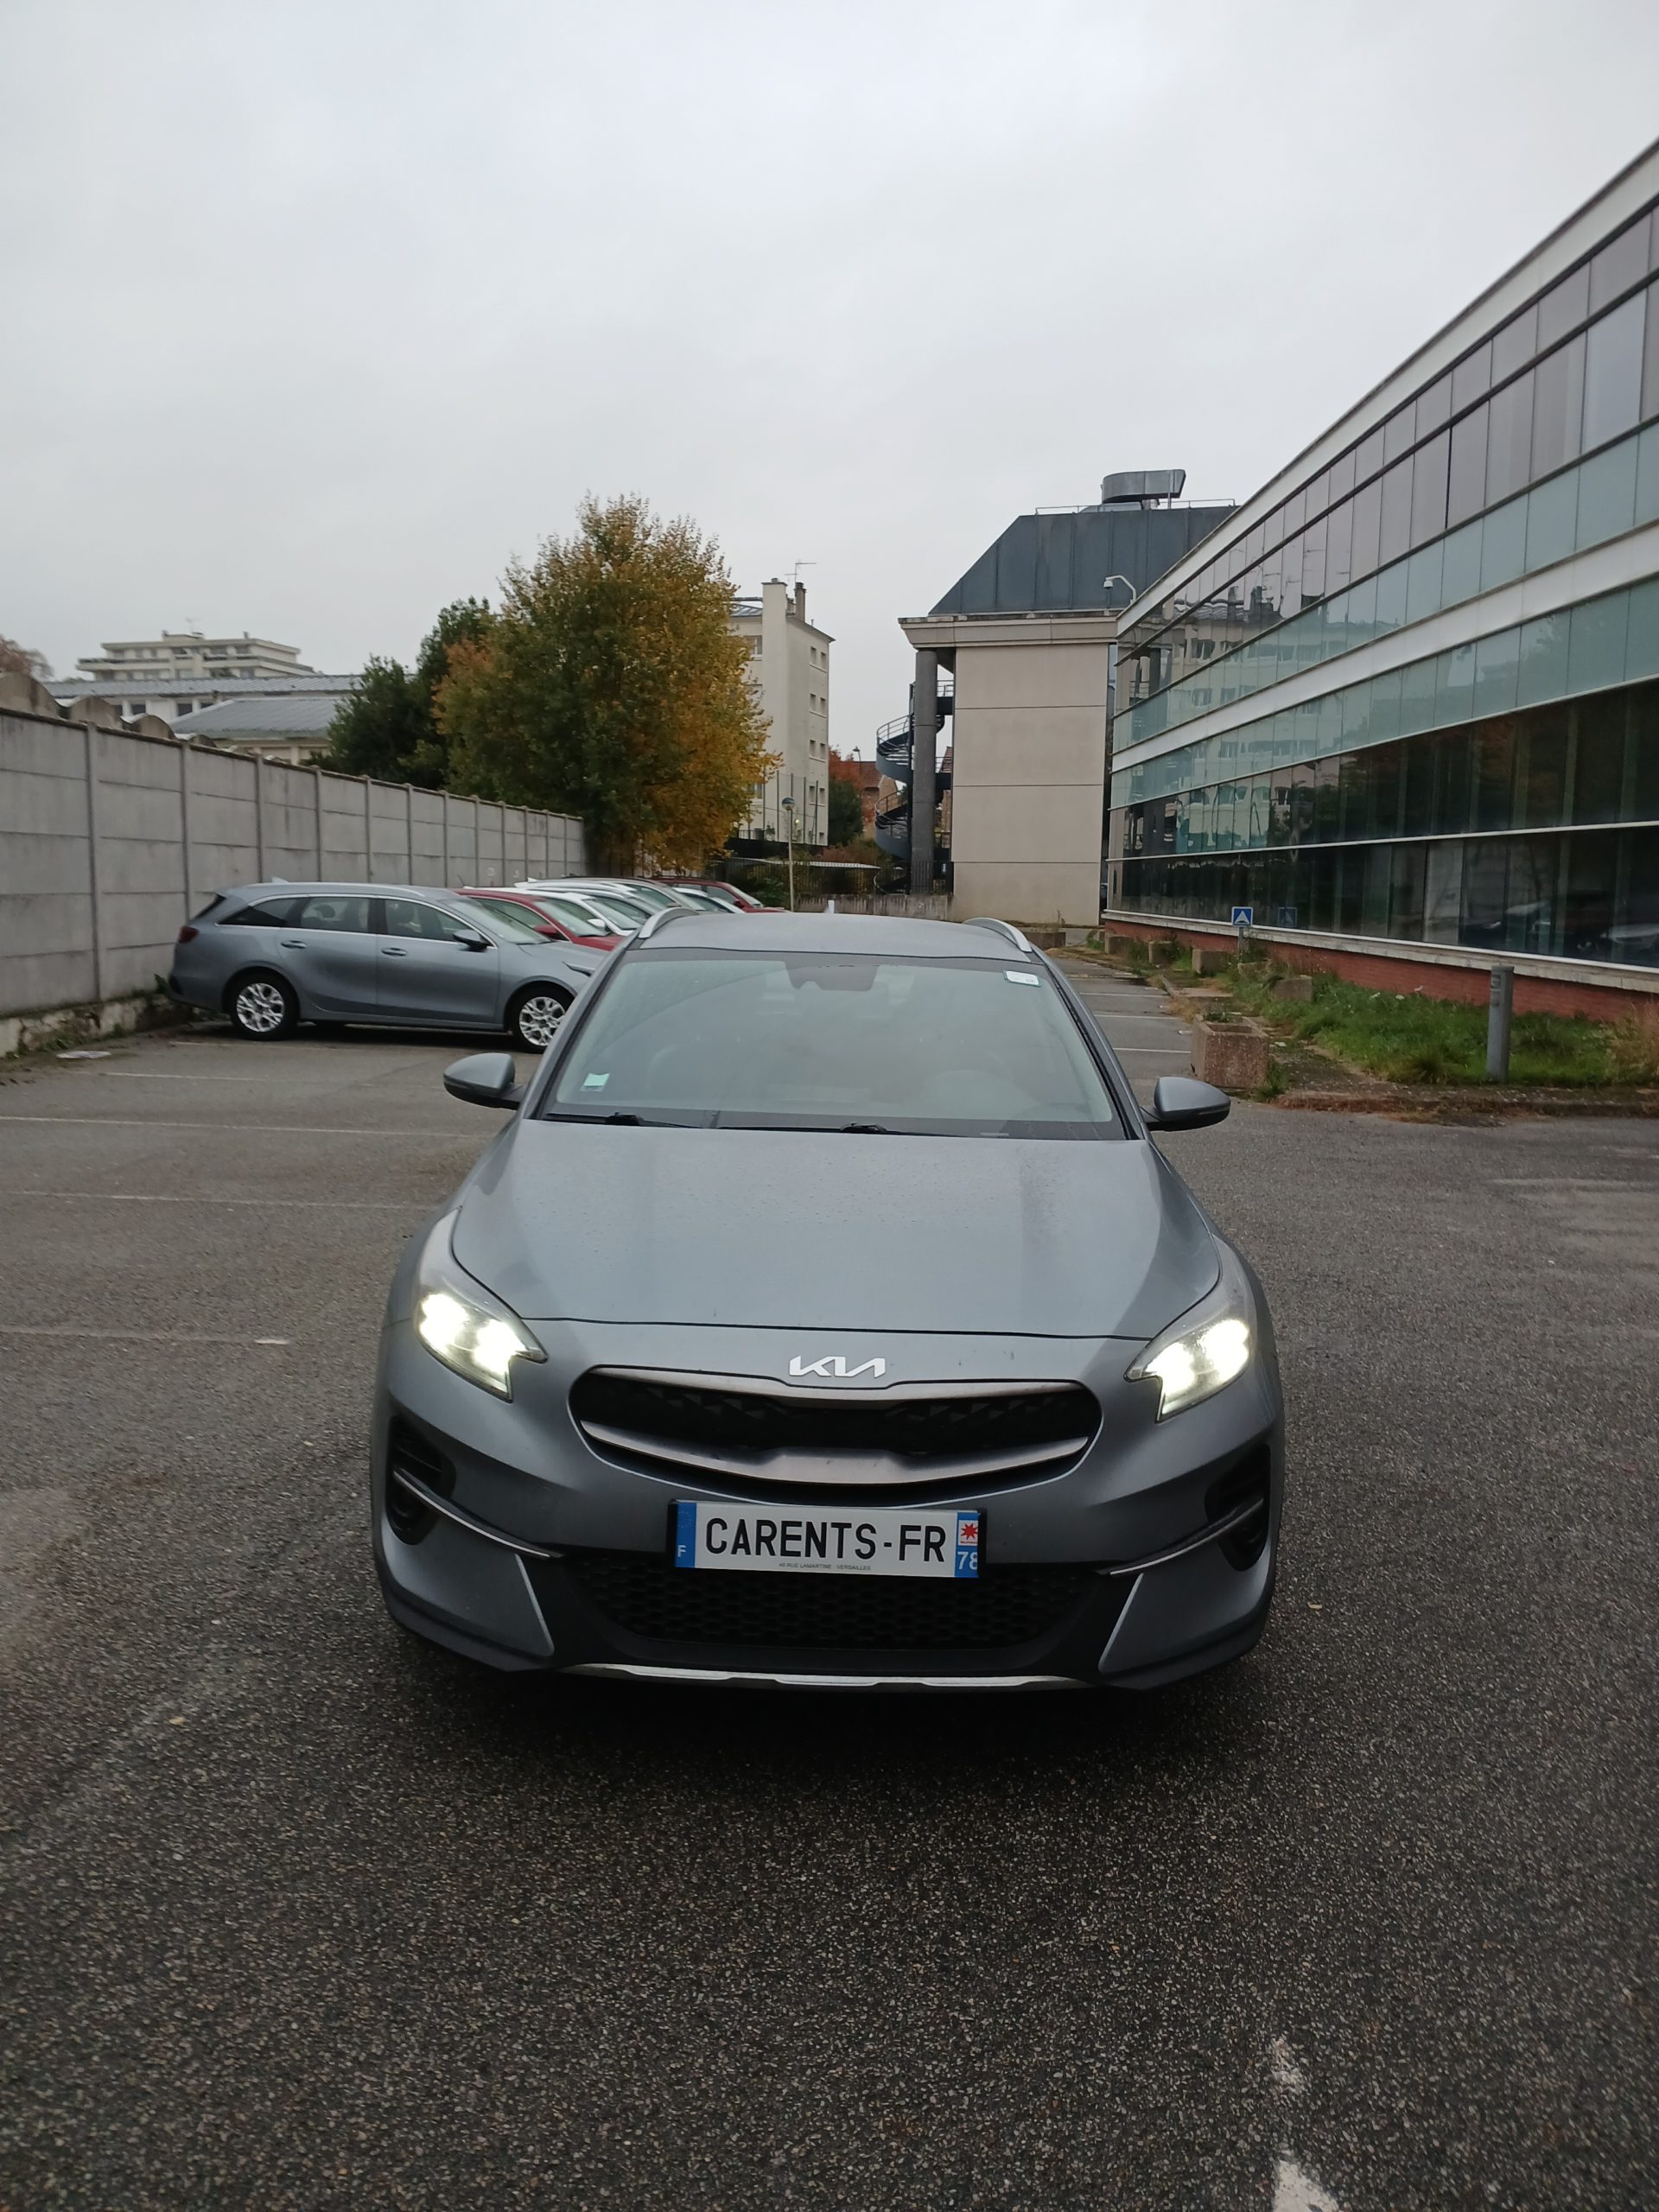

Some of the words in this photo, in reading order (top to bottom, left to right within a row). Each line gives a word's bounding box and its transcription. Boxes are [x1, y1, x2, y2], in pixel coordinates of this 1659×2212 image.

[789, 1355, 886, 1379] KIA
[705, 1517, 947, 1562] CARENTS-FR
[677, 1544, 687, 1557] F
[957, 1551, 978, 1570] 78
